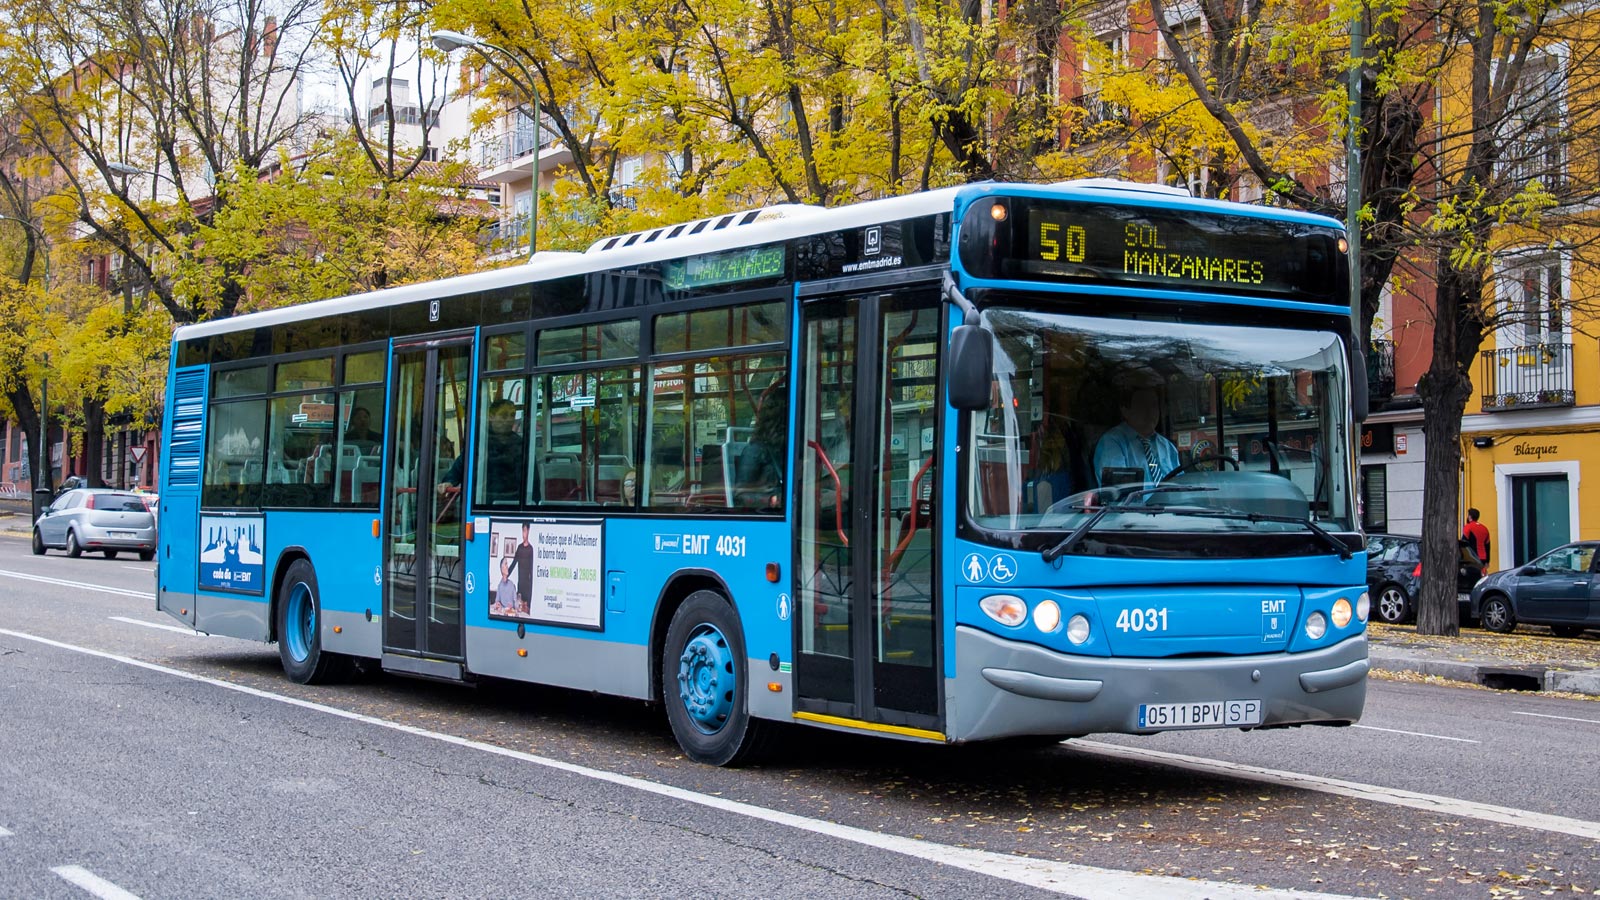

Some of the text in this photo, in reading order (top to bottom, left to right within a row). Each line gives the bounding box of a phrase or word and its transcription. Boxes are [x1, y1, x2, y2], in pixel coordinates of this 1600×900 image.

[1040, 222, 1086, 263] 50
[1124, 223, 1167, 249] SOL
[842, 256, 902, 273] www.emtmadrid.es
[1124, 250, 1264, 284] MANZANARES
[1513, 441, 1558, 460] Blázquez
[538, 532, 598, 547] No dejes que el Alzheimer
[682, 534, 710, 555] EMT
[715, 535, 746, 557] 4031
[537, 546, 567, 560] lo borre todo
[550, 566, 572, 580] MEMORIA
[573, 567, 579, 580] al
[1261, 600, 1286, 613] EMT
[1116, 608, 1168, 633] 4031
[1148, 706, 1187, 725] 0511
[1192, 704, 1221, 723] BPV
